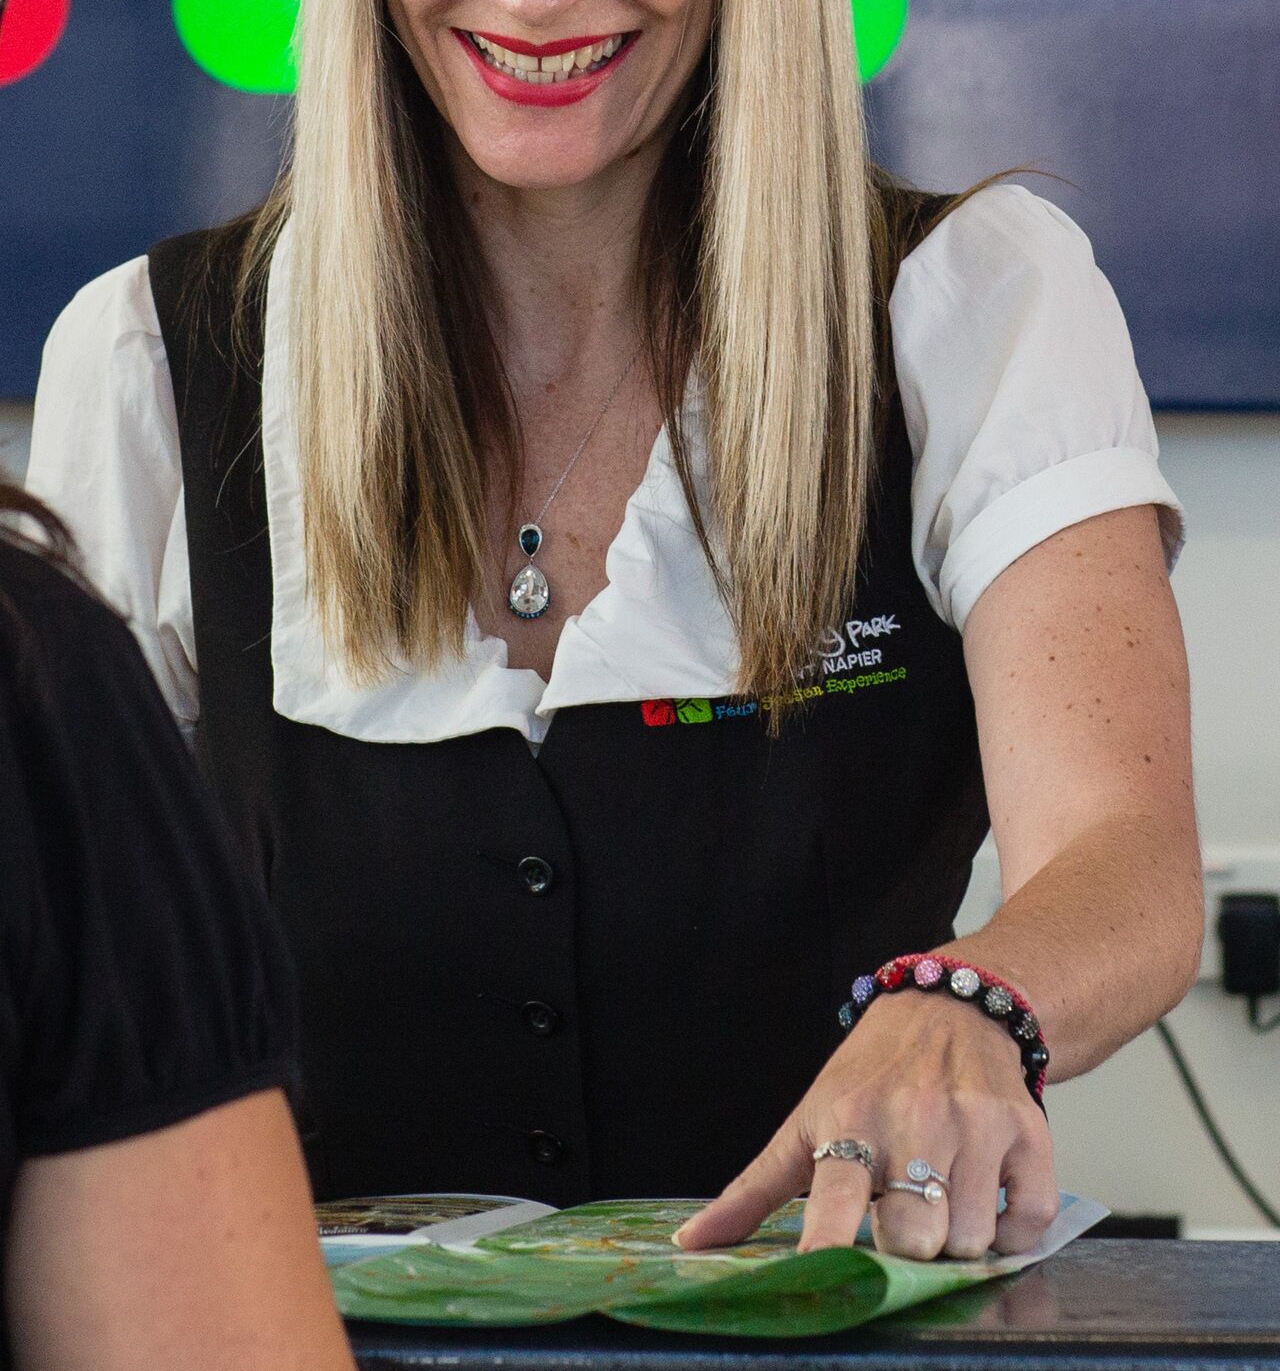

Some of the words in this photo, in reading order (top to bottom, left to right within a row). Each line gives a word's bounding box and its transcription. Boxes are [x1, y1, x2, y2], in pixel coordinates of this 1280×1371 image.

[845, 614, 901, 648] PARK
[822, 649, 882, 674] NAPIER
[715, 702, 757, 720] Four
[826, 666, 907, 693] Experience
